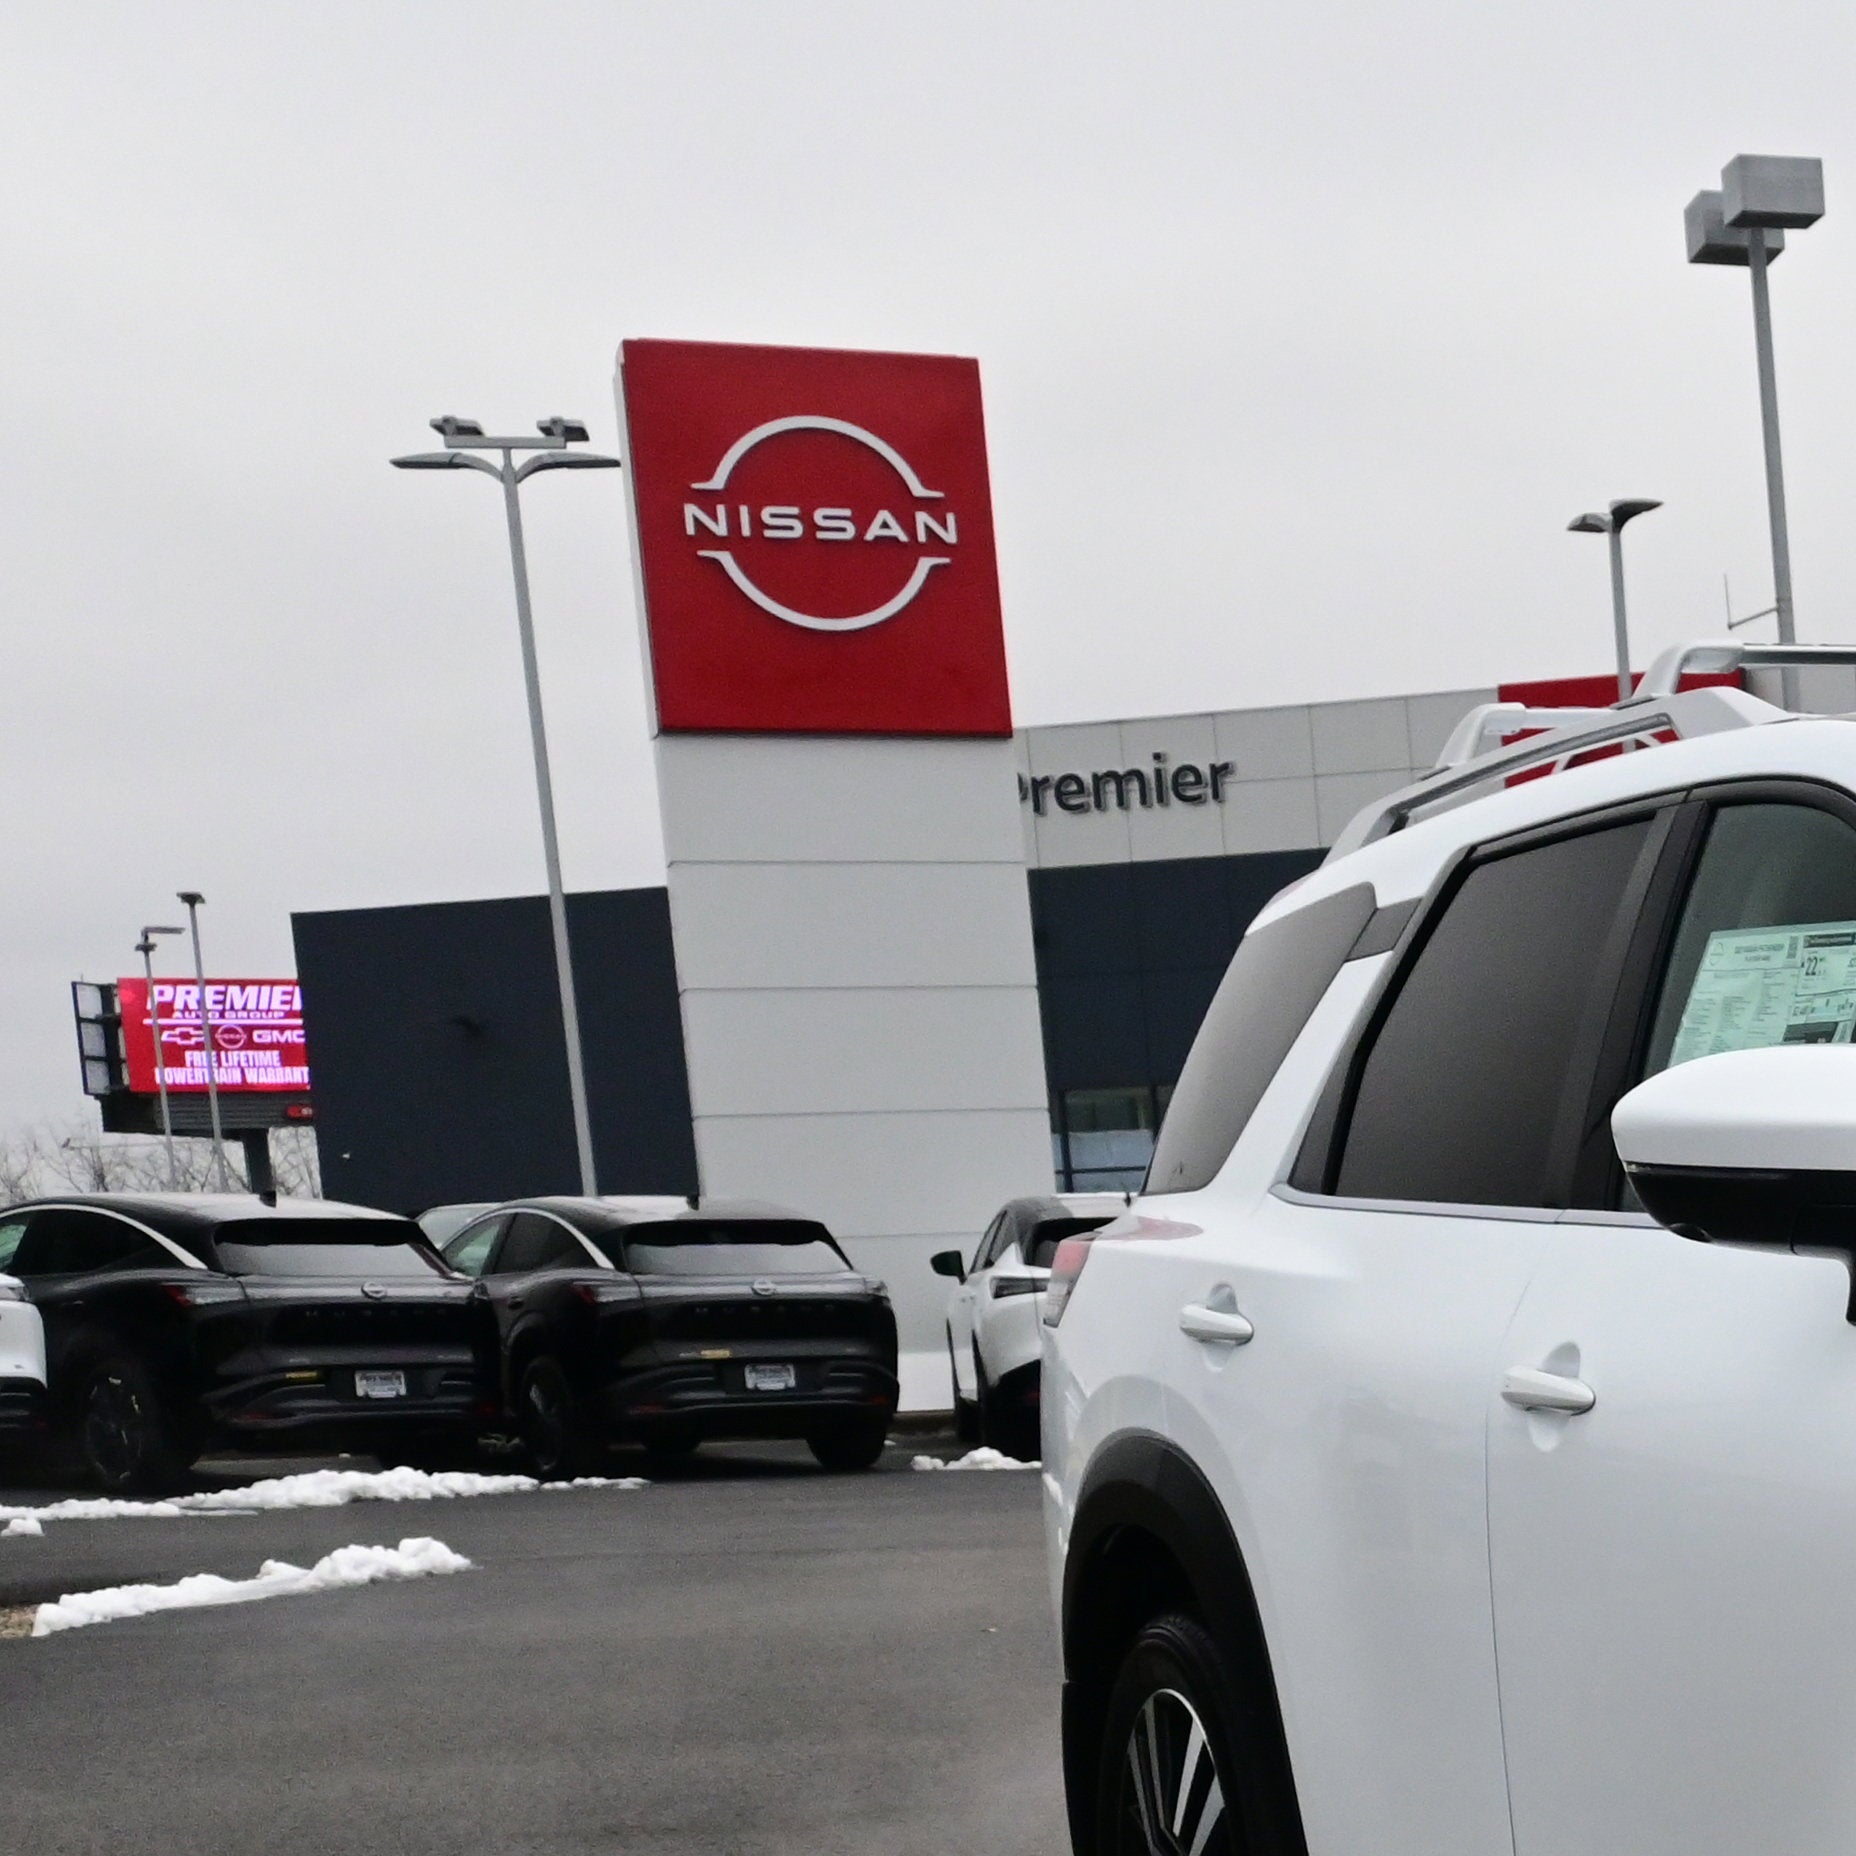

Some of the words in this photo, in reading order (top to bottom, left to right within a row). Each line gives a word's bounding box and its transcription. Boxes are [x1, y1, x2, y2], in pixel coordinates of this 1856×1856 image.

[684, 503, 957, 544] NISSAN
[1018, 752, 1234, 815] remier
[224, 1010, 285, 1019] GROUP
[220, 1050, 281, 1067] LIFETIME
[244, 1066, 309, 1084] WARRANT
